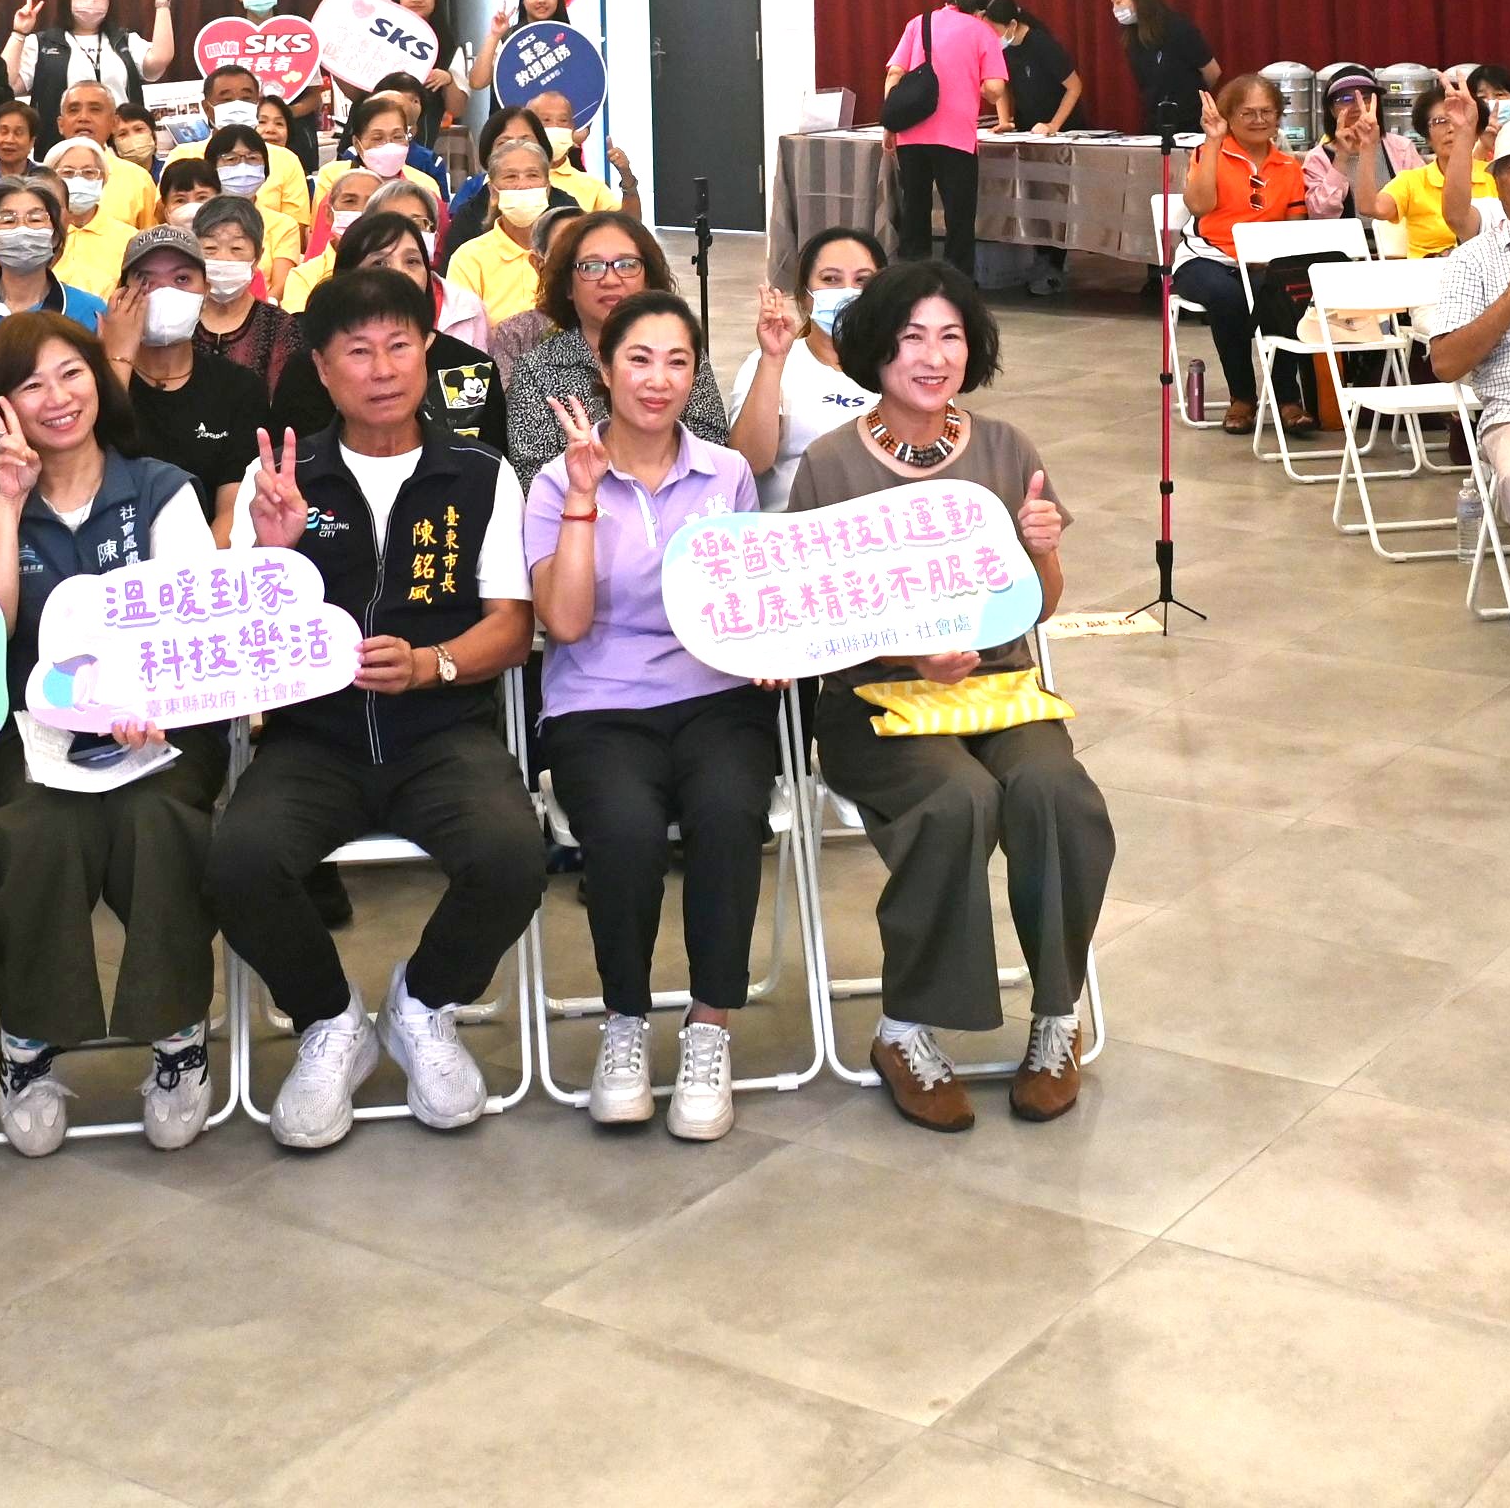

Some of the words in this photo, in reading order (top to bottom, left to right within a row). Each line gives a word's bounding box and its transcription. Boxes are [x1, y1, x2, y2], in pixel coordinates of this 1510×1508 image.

[244, 33, 311, 54] SKS
[369, 18, 434, 60] SKS
[822, 394, 865, 407] SKS
[319, 530, 336, 538] CITY
[320, 522, 350, 531] TAITUNG
[692, 493, 984, 582] 樂齡科技i運動
[97, 539, 120, 567] 陳
[439, 506, 460, 594] 臺東市長
[105, 559, 294, 622] 溫暖到家
[701, 546, 1009, 637] 健康精彩不服老
[140, 619, 329, 684] 科技樂活
